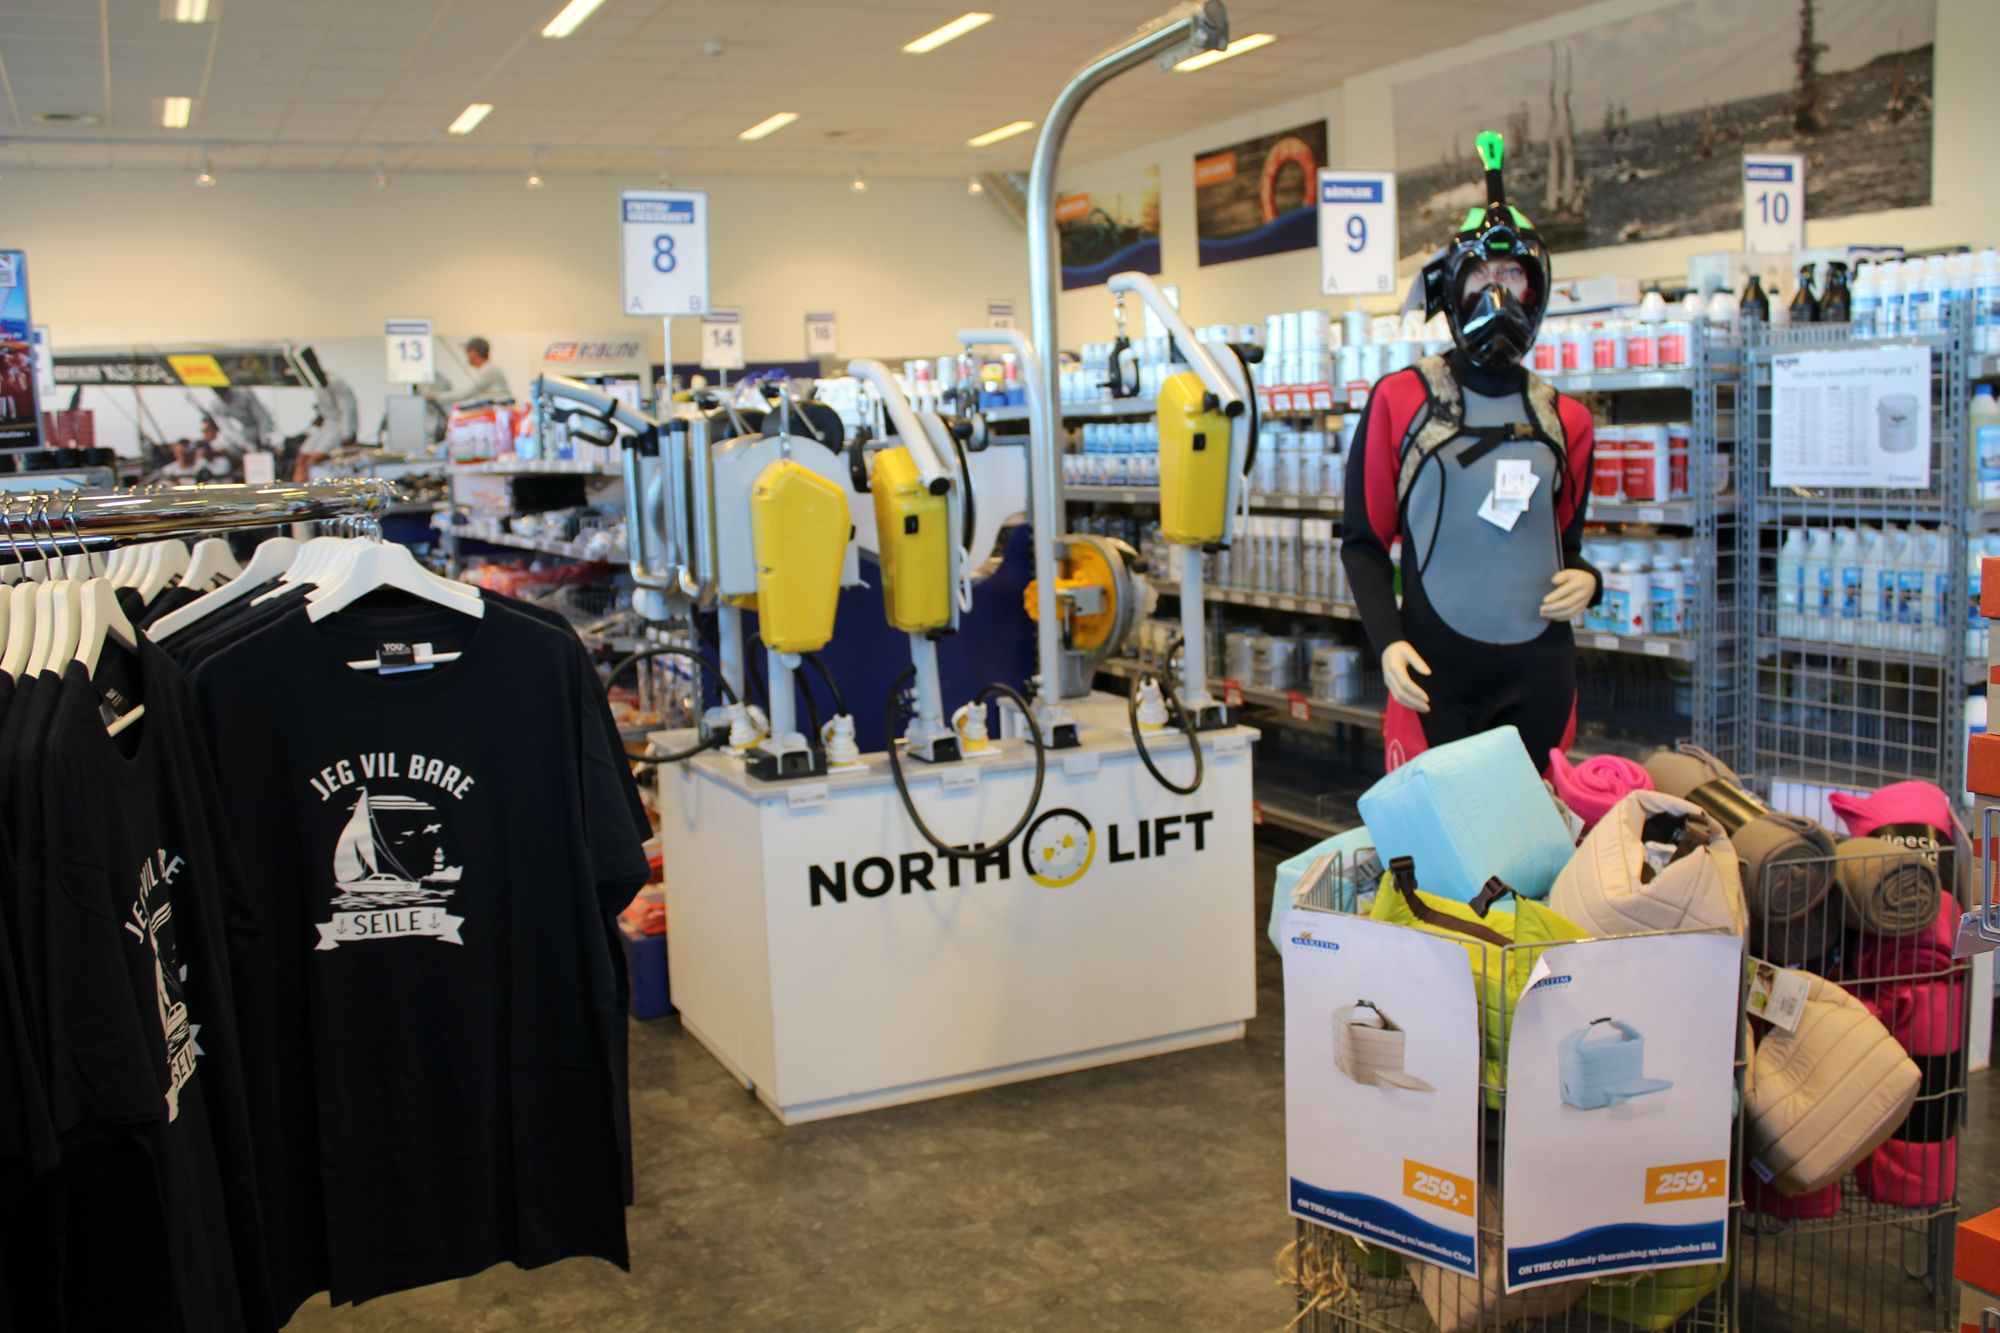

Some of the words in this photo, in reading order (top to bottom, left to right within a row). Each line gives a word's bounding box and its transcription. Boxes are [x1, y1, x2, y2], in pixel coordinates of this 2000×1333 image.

[1756, 190, 1789, 224] 10
[1346, 214, 1367, 253] 9
[653, 235, 676, 273] 8
[1327, 275, 1338, 289] A
[1378, 275, 1389, 289] B
[631, 297, 642, 310] A
[689, 295, 701, 310] B
[396, 340, 424, 361] 13
[710, 328, 734, 348] 14
[310, 759, 355, 801] JEG
[360, 752, 399, 779] VIL
[407, 754, 475, 800] BARE
[808, 841, 1011, 907] NORTH
[1107, 811, 1215, 864] LIFT
[353, 911, 422, 935] SEILE
[1294, 937, 1338, 949] MARITIM
[1412, 1170, 1468, 1206] 259,-
[1655, 1169, 1718, 1195] 259,-
[1297, 1198, 1311, 1209] ON
[1311, 1201, 1326, 1214] THE
[1326, 1207, 1338, 1219] GO
[1338, 1210, 1364, 1228] Handy
[1363, 1221, 1407, 1243] thermobag
[1453, 1250, 1473, 1265] Clay
[1518, 1266, 1534, 1276] ON
[1534, 1263, 1553, 1273] THE
[1553, 1259, 1567, 1270] GO
[1567, 1255, 1597, 1269] Handy
[1598, 1250, 1647, 1263] thermobag
